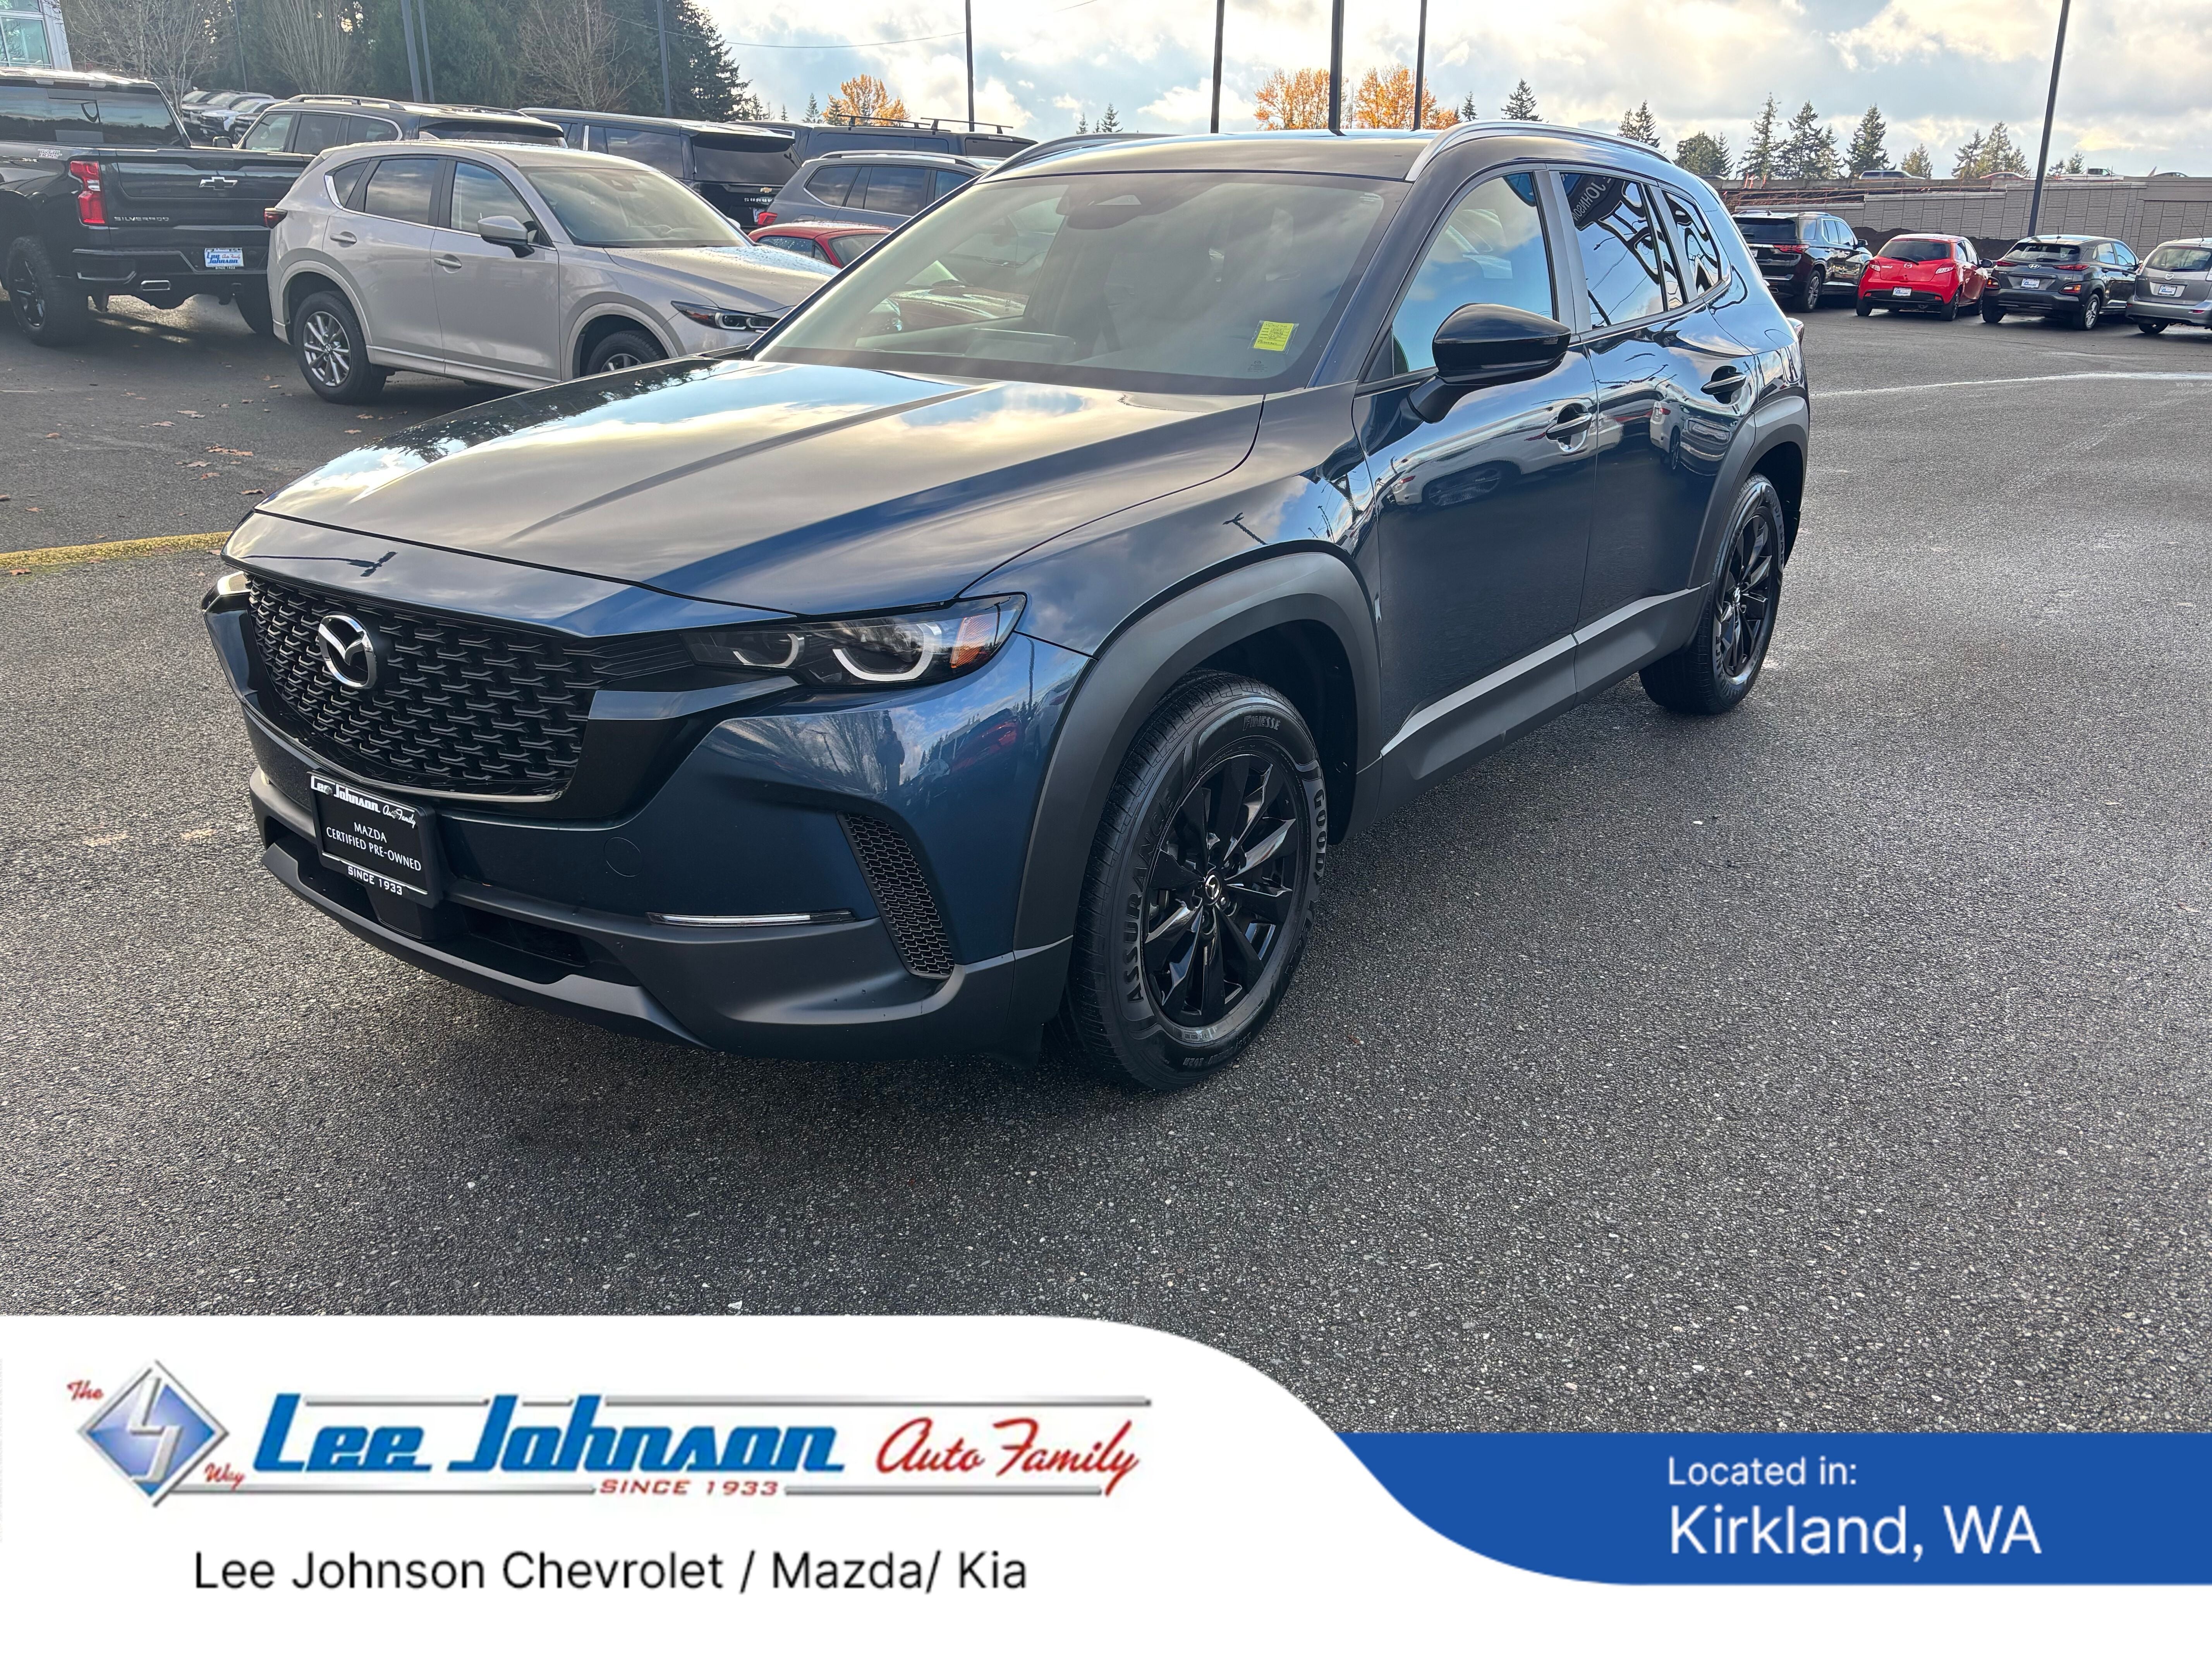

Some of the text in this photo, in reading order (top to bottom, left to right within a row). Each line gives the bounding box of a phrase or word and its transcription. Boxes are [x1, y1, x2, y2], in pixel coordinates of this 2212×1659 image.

[1243, 715, 1281, 731] FINESSE
[333, 783, 381, 813] Johnson
[395, 808, 416, 829] Family
[354, 822, 387, 843] MAZDA
[326, 827, 421, 871] CERTIFIED PRE-OWNED
[348, 866, 402, 895] SINCE 1933
